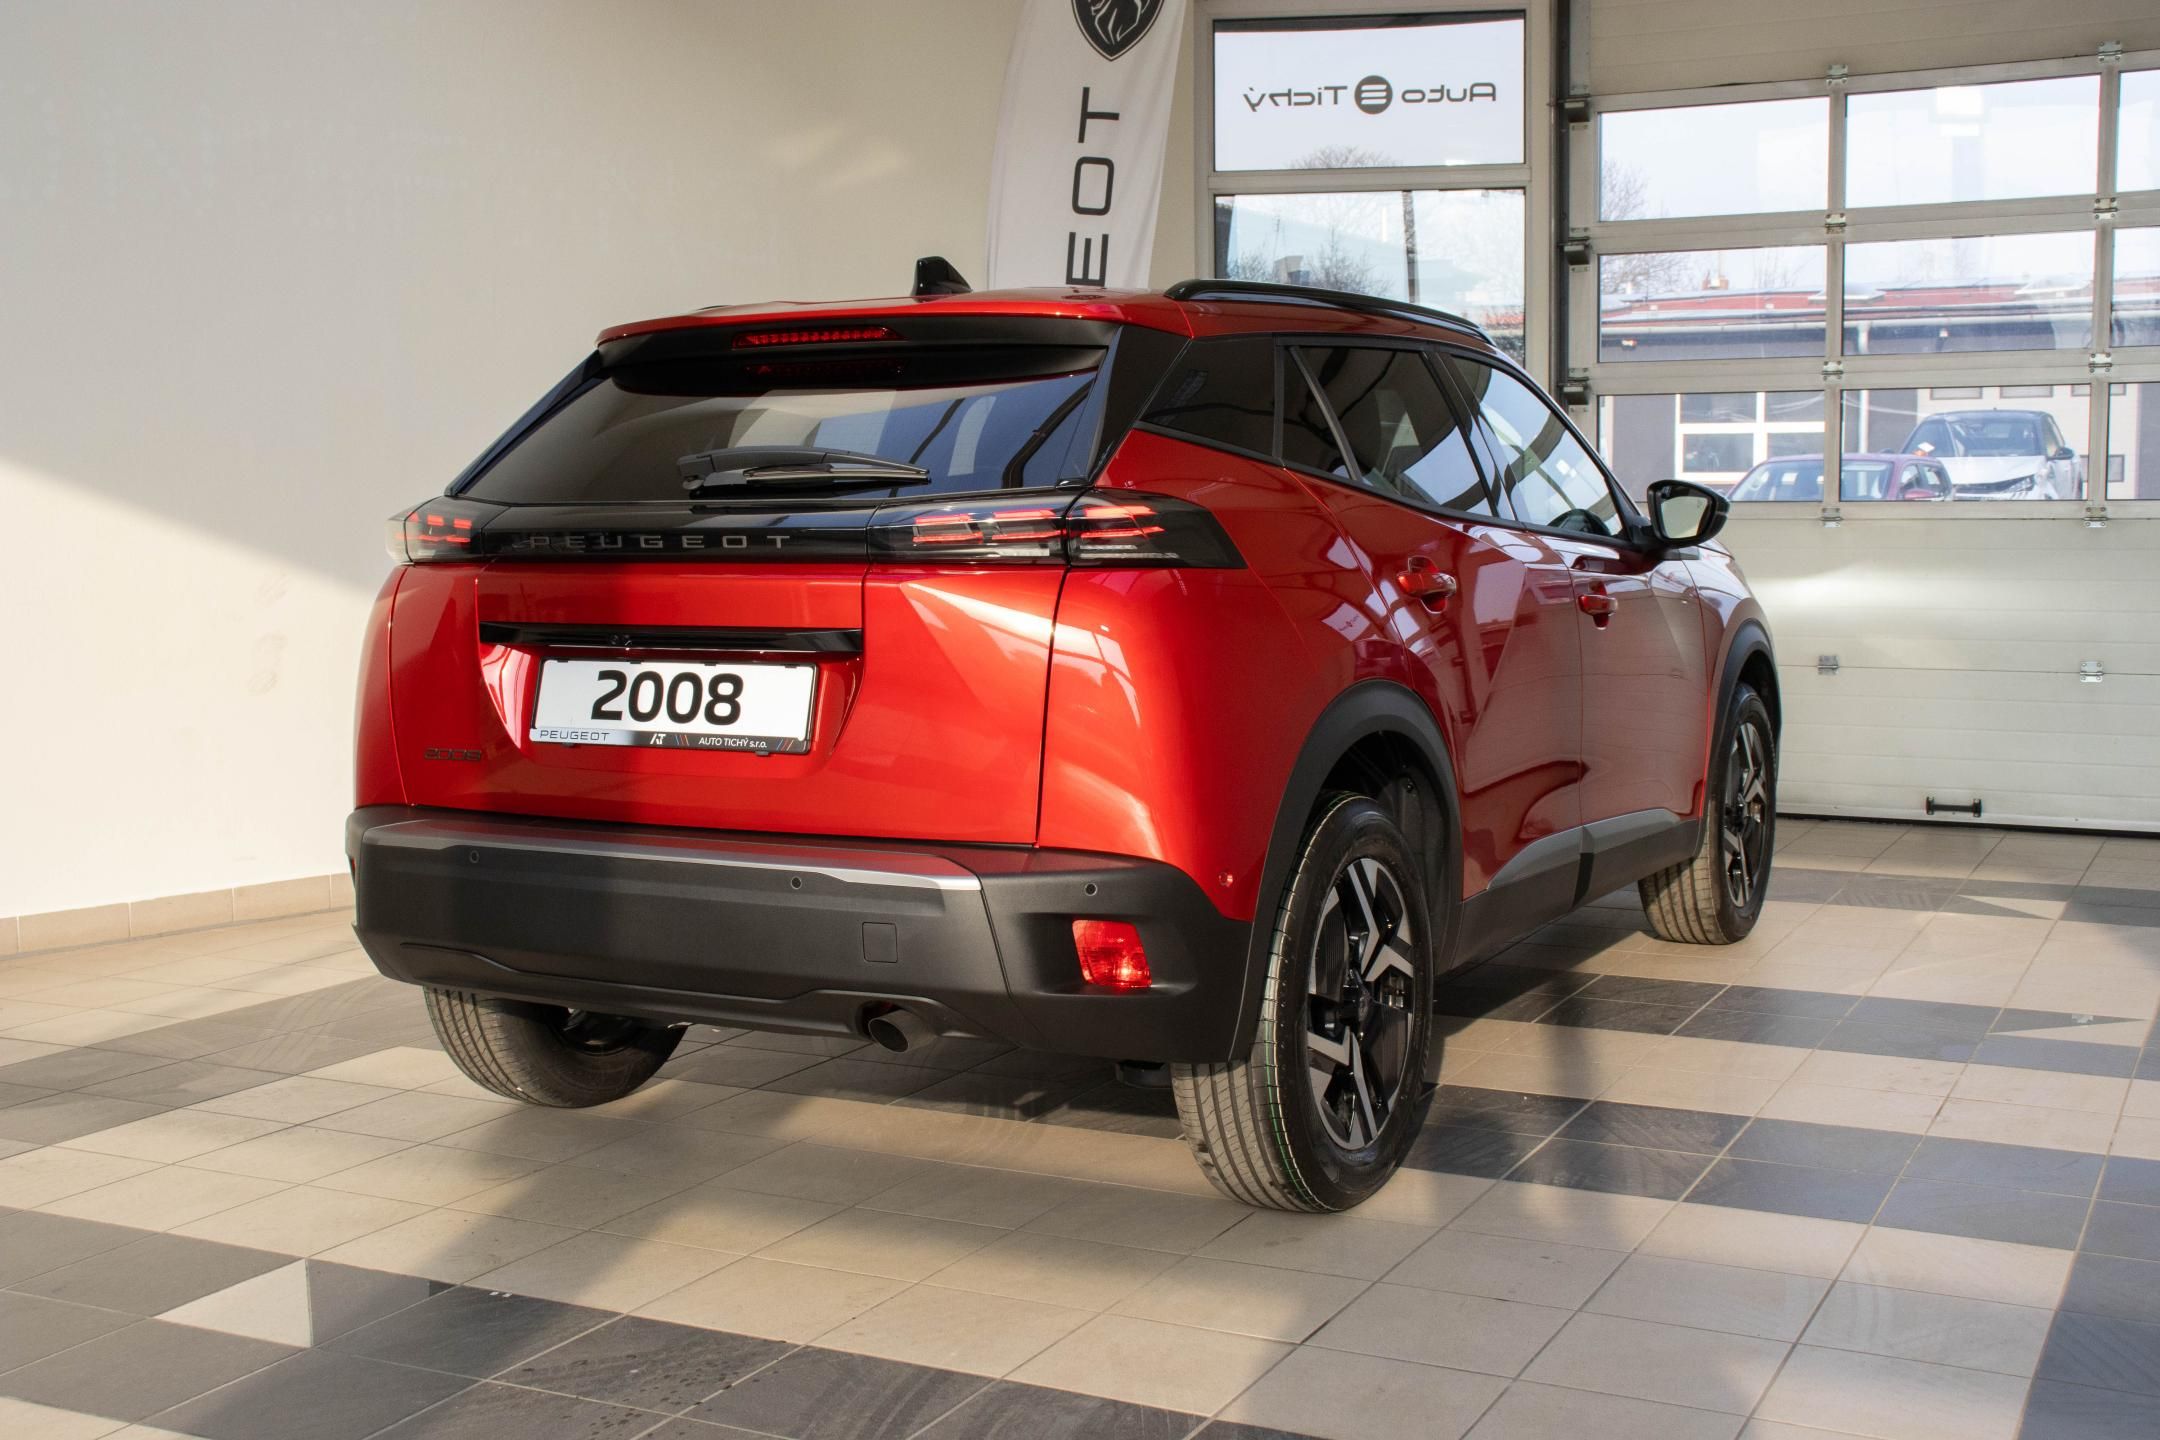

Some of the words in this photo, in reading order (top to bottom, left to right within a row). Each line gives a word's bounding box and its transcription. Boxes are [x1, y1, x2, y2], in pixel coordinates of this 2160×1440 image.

[1065, 86, 1120, 287] EOT
[529, 535, 790, 549] PEUGEOT
[591, 669, 744, 726] 2008
[539, 730, 610, 742] PEUGEOT
[698, 736, 723, 746] AUTO
[724, 737, 749, 747] TICHÝ
